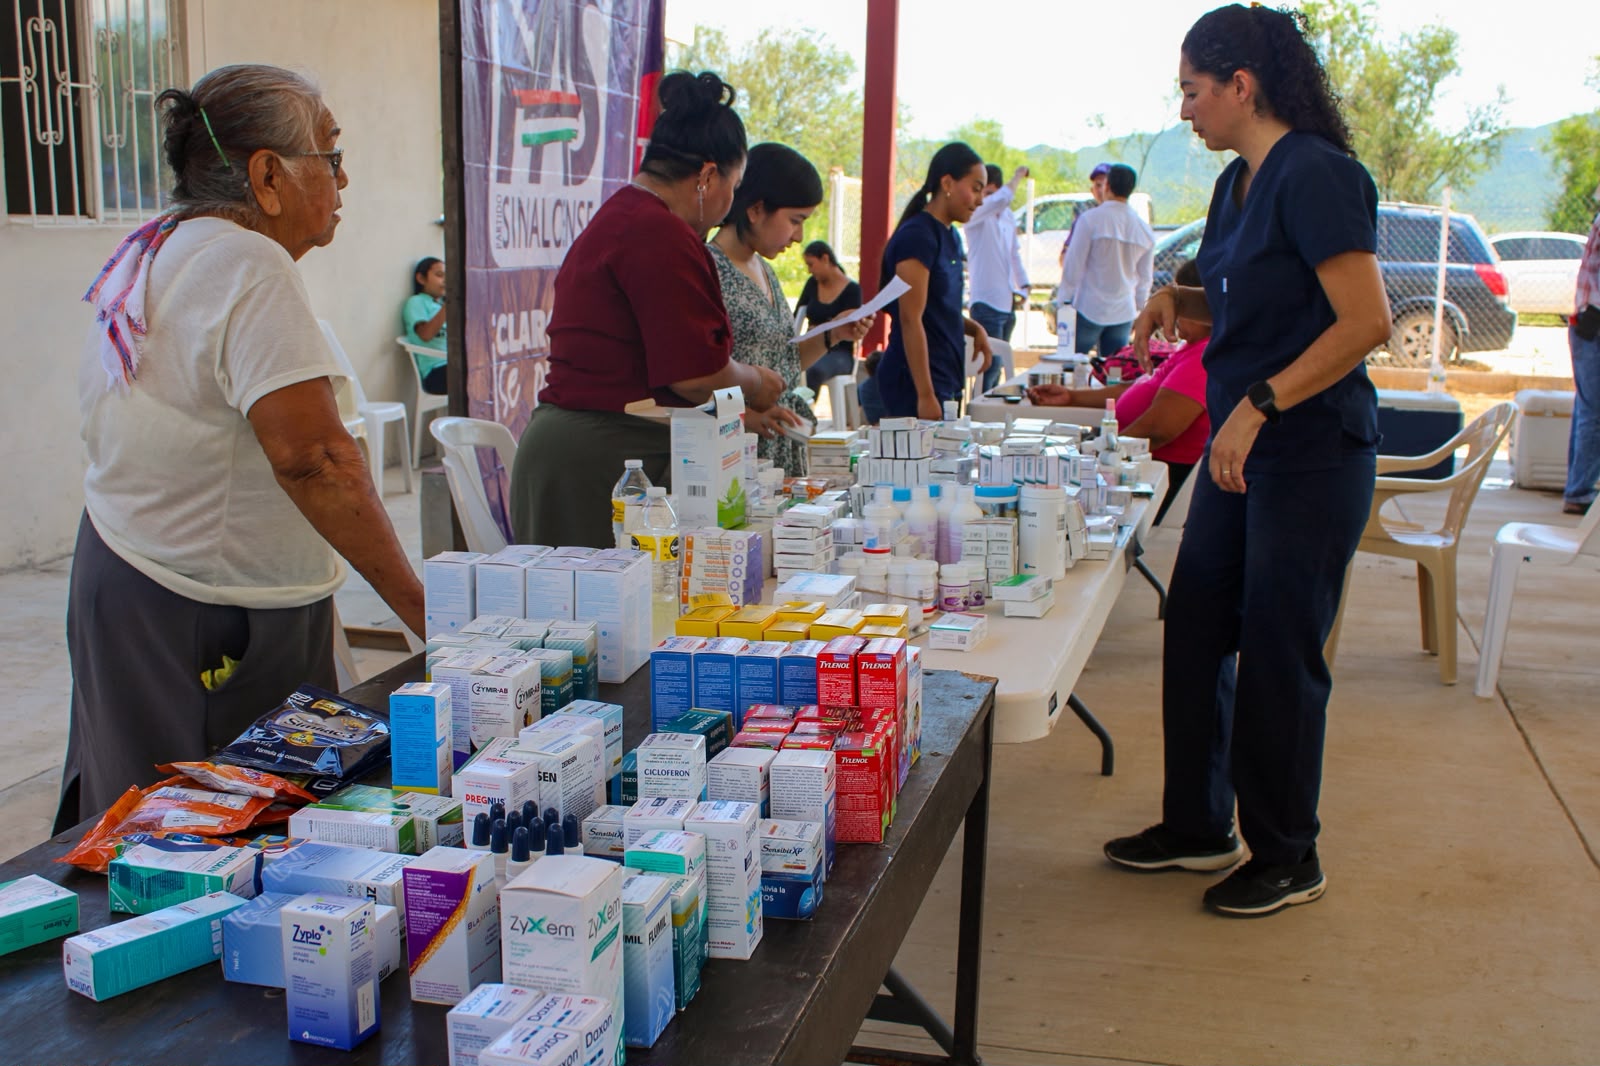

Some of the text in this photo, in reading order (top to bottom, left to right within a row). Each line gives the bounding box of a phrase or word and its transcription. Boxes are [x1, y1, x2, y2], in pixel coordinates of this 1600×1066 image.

[820, 661, 850, 669] TYLENOL
[861, 662, 892, 670] TYLENOL
[644, 769, 690, 777] CICLOFERON
[293, 924, 322, 944] Zyplo
[648, 915, 667, 946] FLUMIL
[623, 935, 643, 944] MIL
[527, 996, 562, 1023] Daxon
[585, 1012, 613, 1048] Daxon
